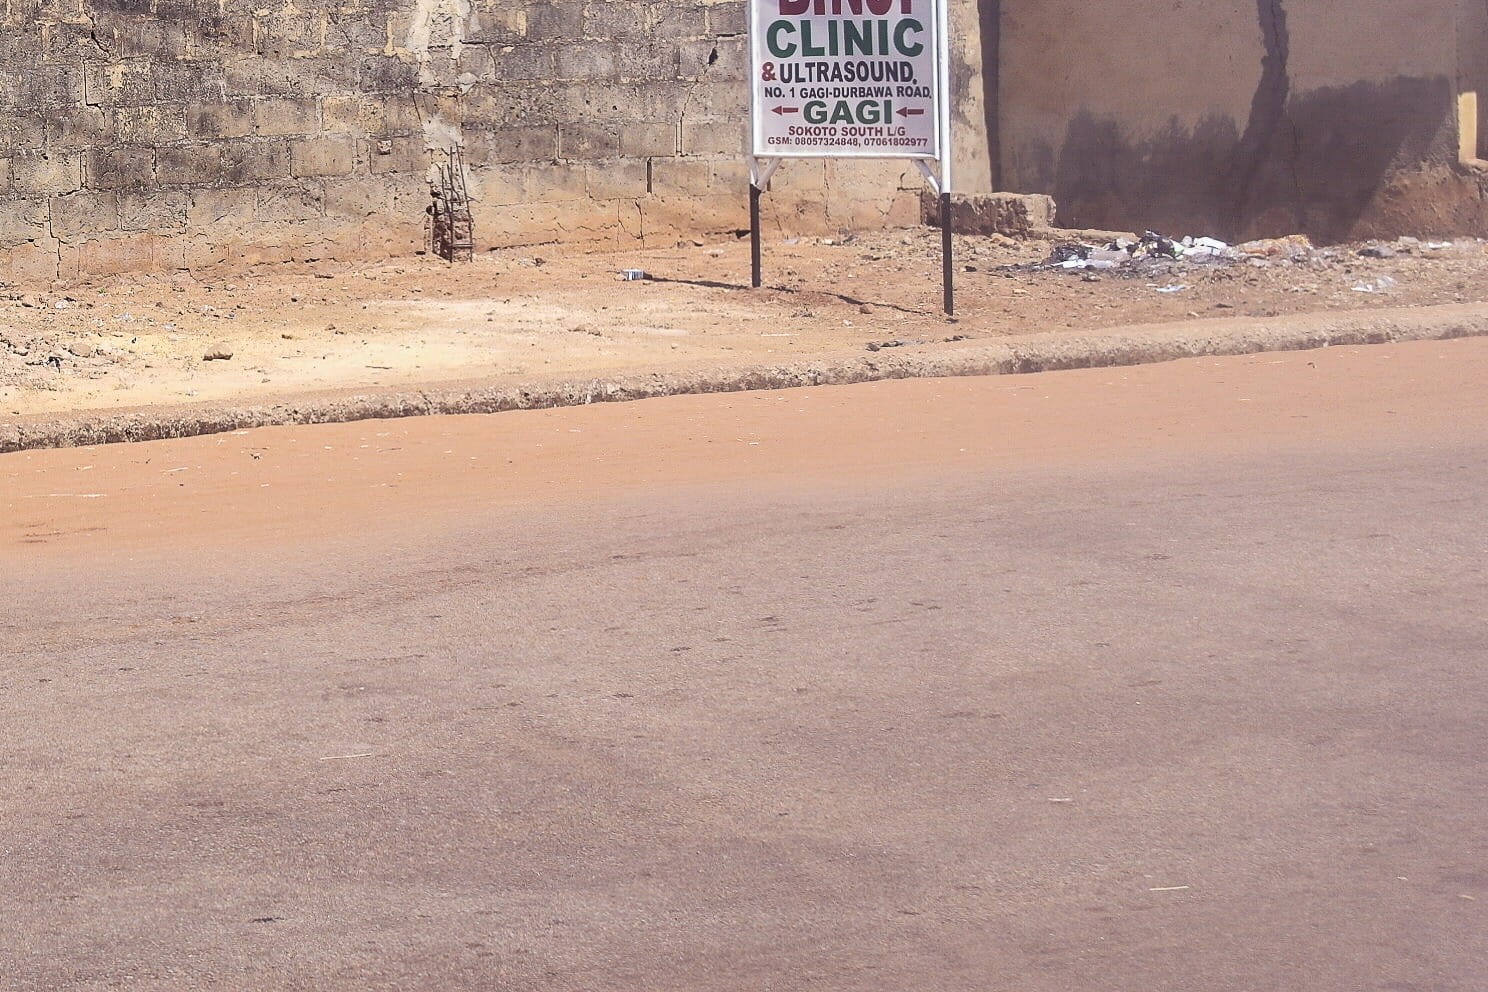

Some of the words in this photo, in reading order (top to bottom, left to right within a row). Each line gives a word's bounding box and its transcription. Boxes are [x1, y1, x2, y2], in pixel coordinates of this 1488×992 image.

[766, 18, 924, 58] CLINIC
[762, 61, 777, 82] &
[764, 87, 785, 98] NO.
[789, 87, 795, 98] 1
[799, 86, 893, 99] GAGI-DURBAWA
[803, 99, 893, 125] GAGI
[788, 126, 837, 137] SOKOTO
[841, 126, 883, 137] SOUTH
[887, 126, 906, 137] L/G
[768, 136, 792, 145] GSM:
[864, 137, 928, 147] 07061802977
